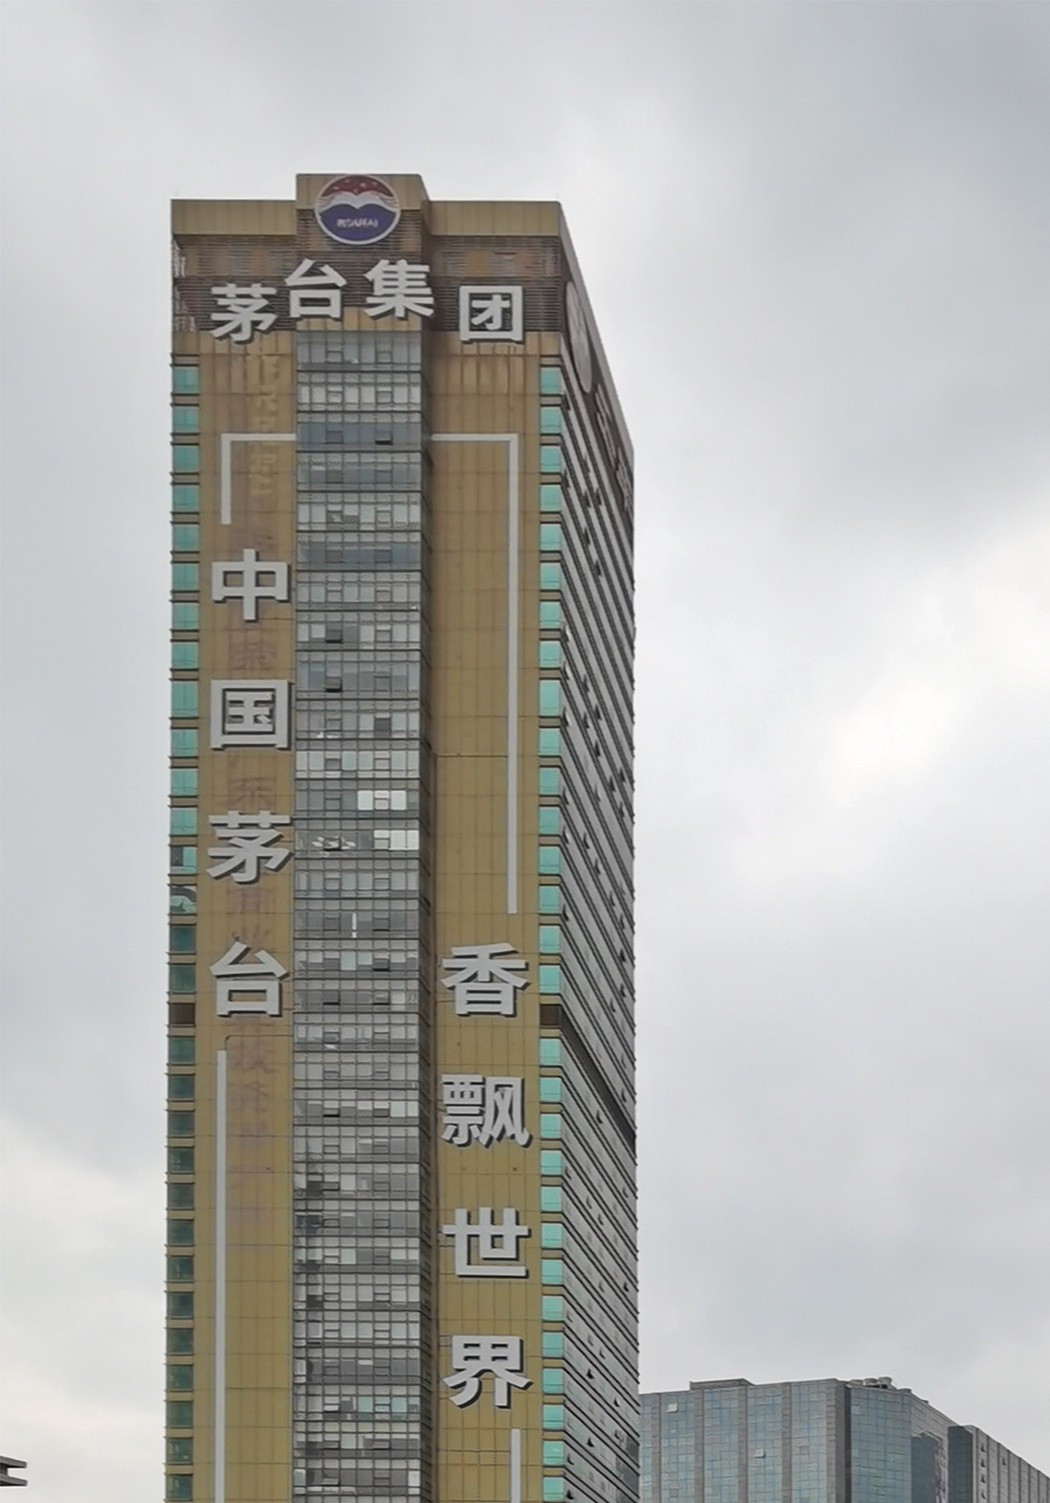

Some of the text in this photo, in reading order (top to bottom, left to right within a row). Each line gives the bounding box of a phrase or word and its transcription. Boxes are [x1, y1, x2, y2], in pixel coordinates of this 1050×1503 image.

[210, 259, 524, 342] 茅台集团
[207, 549, 291, 1016] 中国茅台
[441, 943, 531, 1408] 香飘世界
